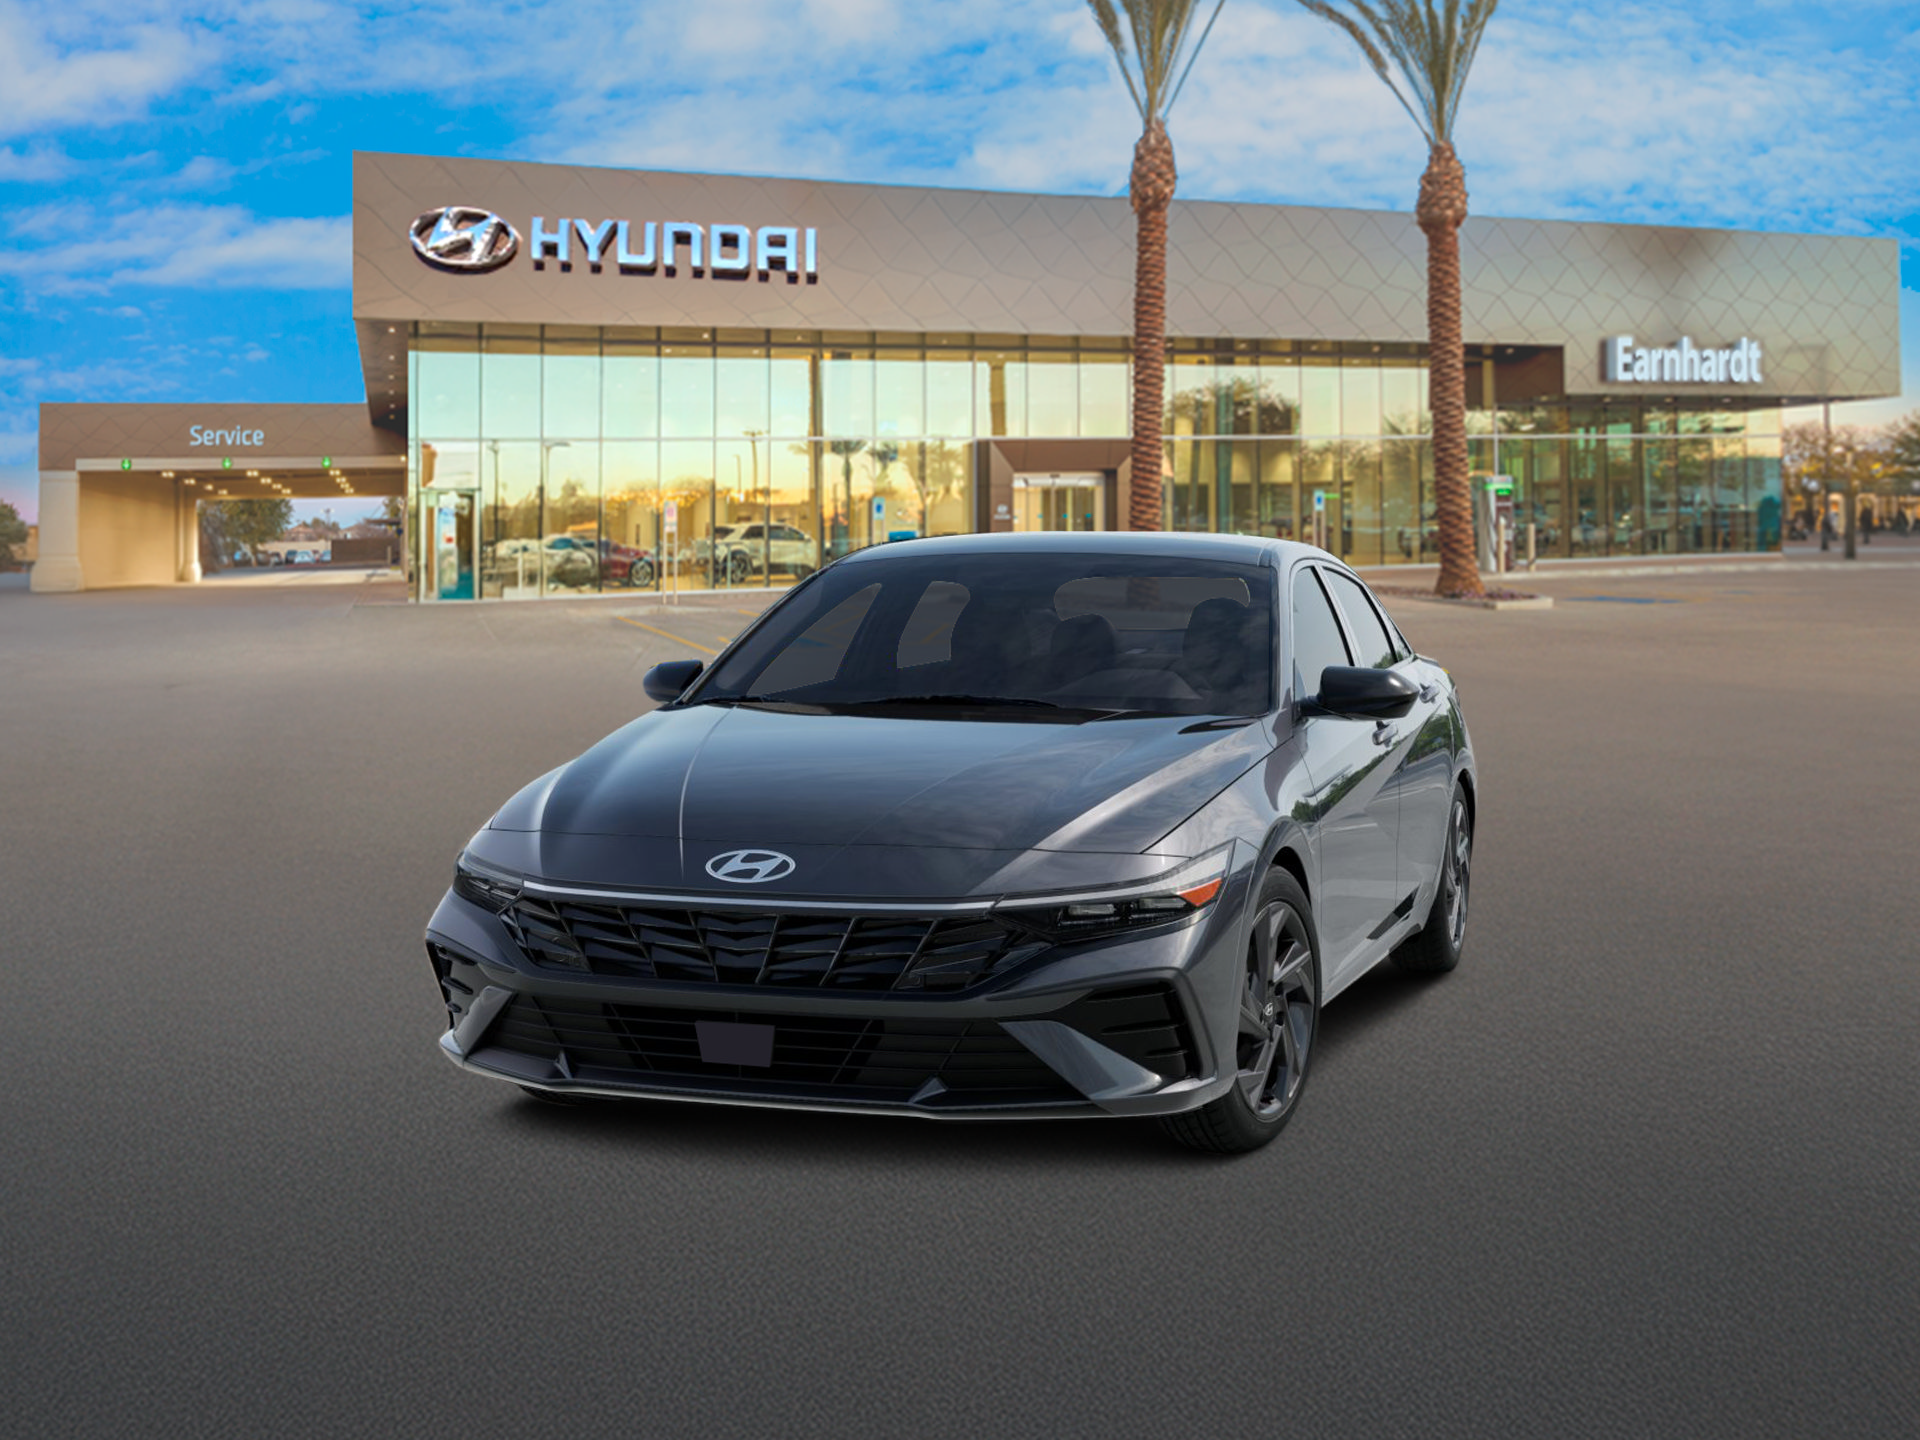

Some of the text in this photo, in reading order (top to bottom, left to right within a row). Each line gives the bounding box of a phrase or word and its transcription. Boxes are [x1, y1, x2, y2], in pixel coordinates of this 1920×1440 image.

[531, 216, 818, 282] HYUNDAI
[1613, 335, 1763, 383] Earnhardt
[189, 424, 265, 446] Service
